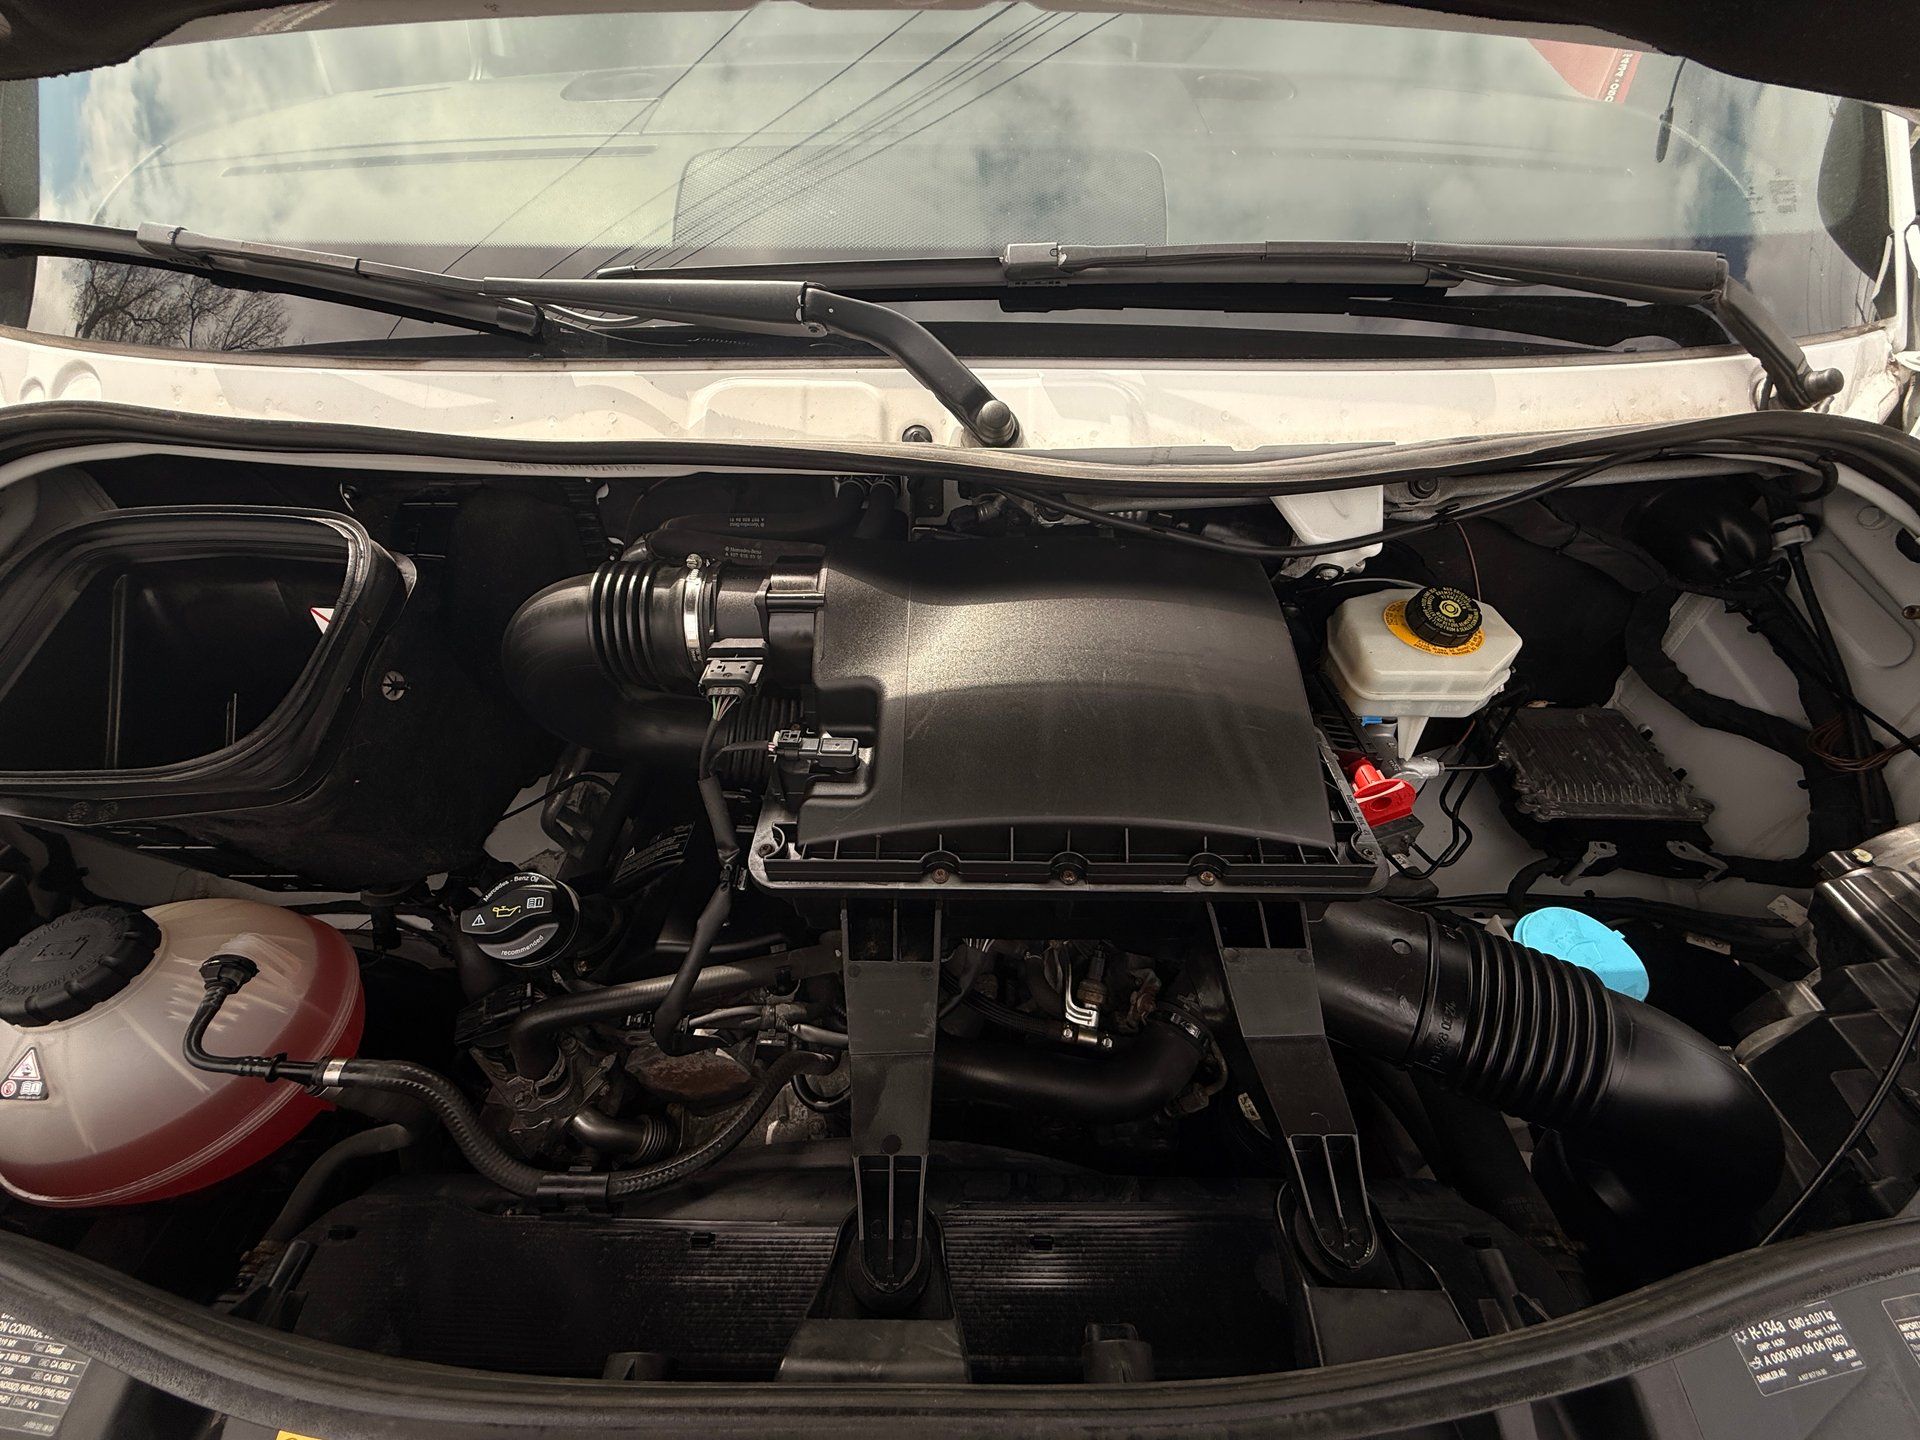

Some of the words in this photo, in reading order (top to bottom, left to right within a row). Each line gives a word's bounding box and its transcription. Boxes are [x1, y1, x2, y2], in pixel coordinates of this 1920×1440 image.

[483, 880, 510, 902] Mercedes
[500, 934, 545, 957] recommended
[1771, 1350, 1788, 1364] 000
[1787, 1345, 1803, 1360] 989
[1803, 1342, 1815, 1356] 06
[1813, 1339, 1826, 1353] 06
[1825, 1333, 1849, 1352] (PAG)
